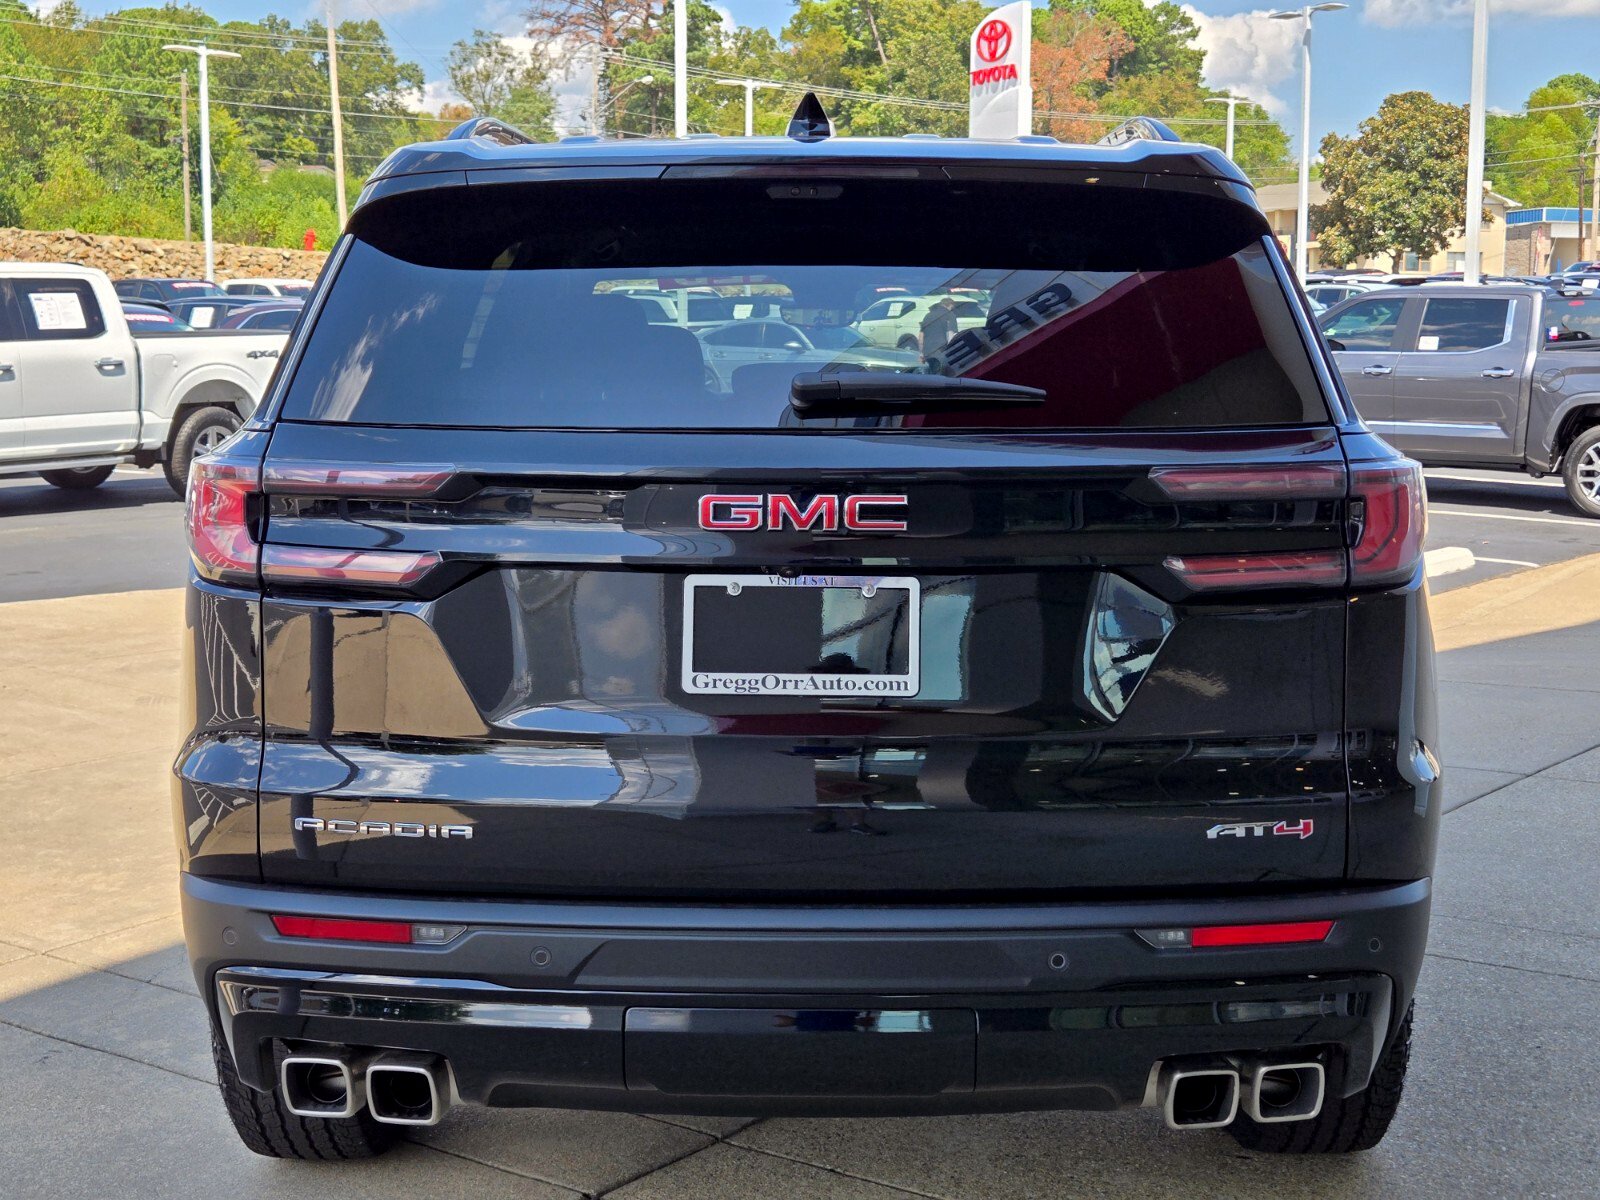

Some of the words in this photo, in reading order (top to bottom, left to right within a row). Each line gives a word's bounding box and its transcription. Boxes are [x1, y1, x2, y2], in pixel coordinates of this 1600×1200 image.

[970, 63, 1018, 86] TOYOTA
[698, 494, 908, 531] GMC
[691, 673, 910, 693] GreggOrrAuto.com
[294, 816, 474, 840] ACADIA
[1206, 819, 1314, 840] AT4
